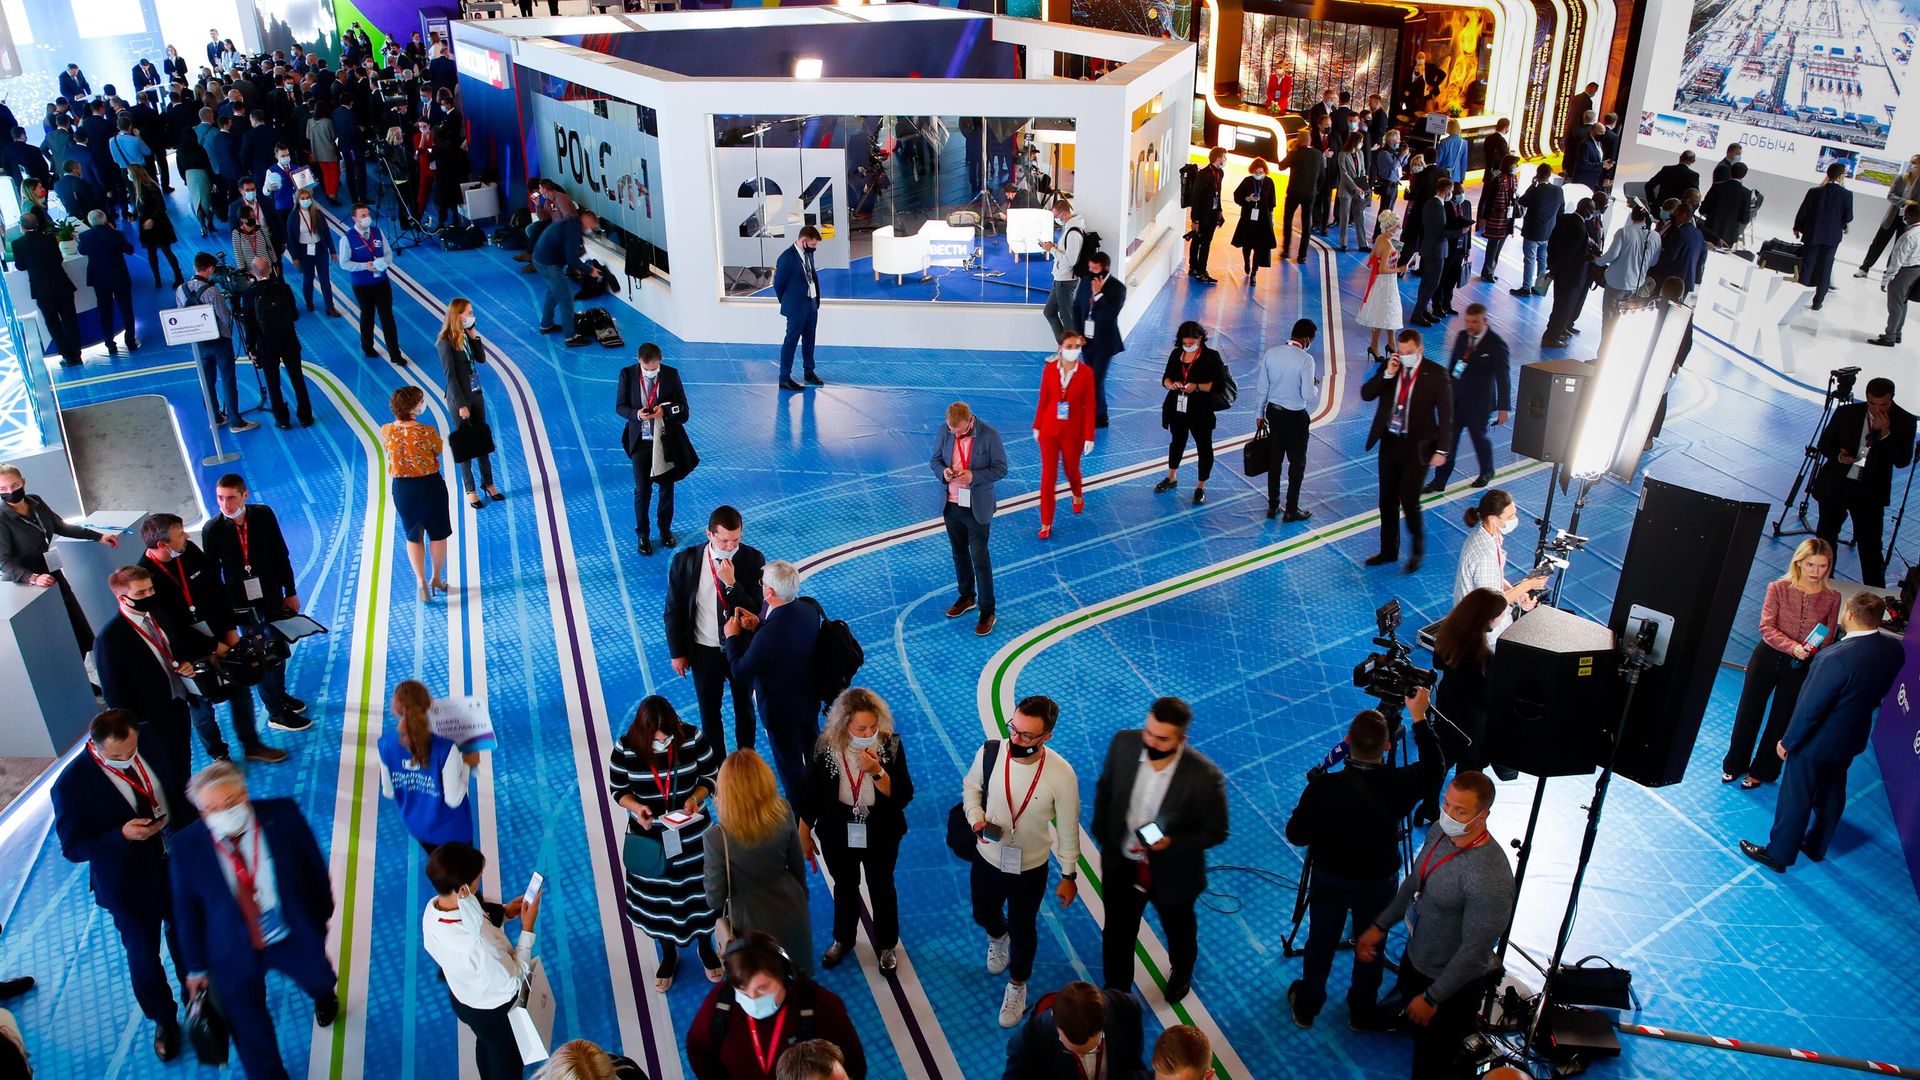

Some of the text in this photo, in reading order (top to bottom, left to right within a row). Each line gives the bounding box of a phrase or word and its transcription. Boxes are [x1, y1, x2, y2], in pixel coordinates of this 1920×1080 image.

[1533, 46, 1543, 85] система
[1739, 133, 1795, 154] ДОБЫЧА
[554, 121, 652, 219] РОССИЯ
[738, 177, 835, 239] 24
[930, 244, 968, 256] ВЕСТИ
